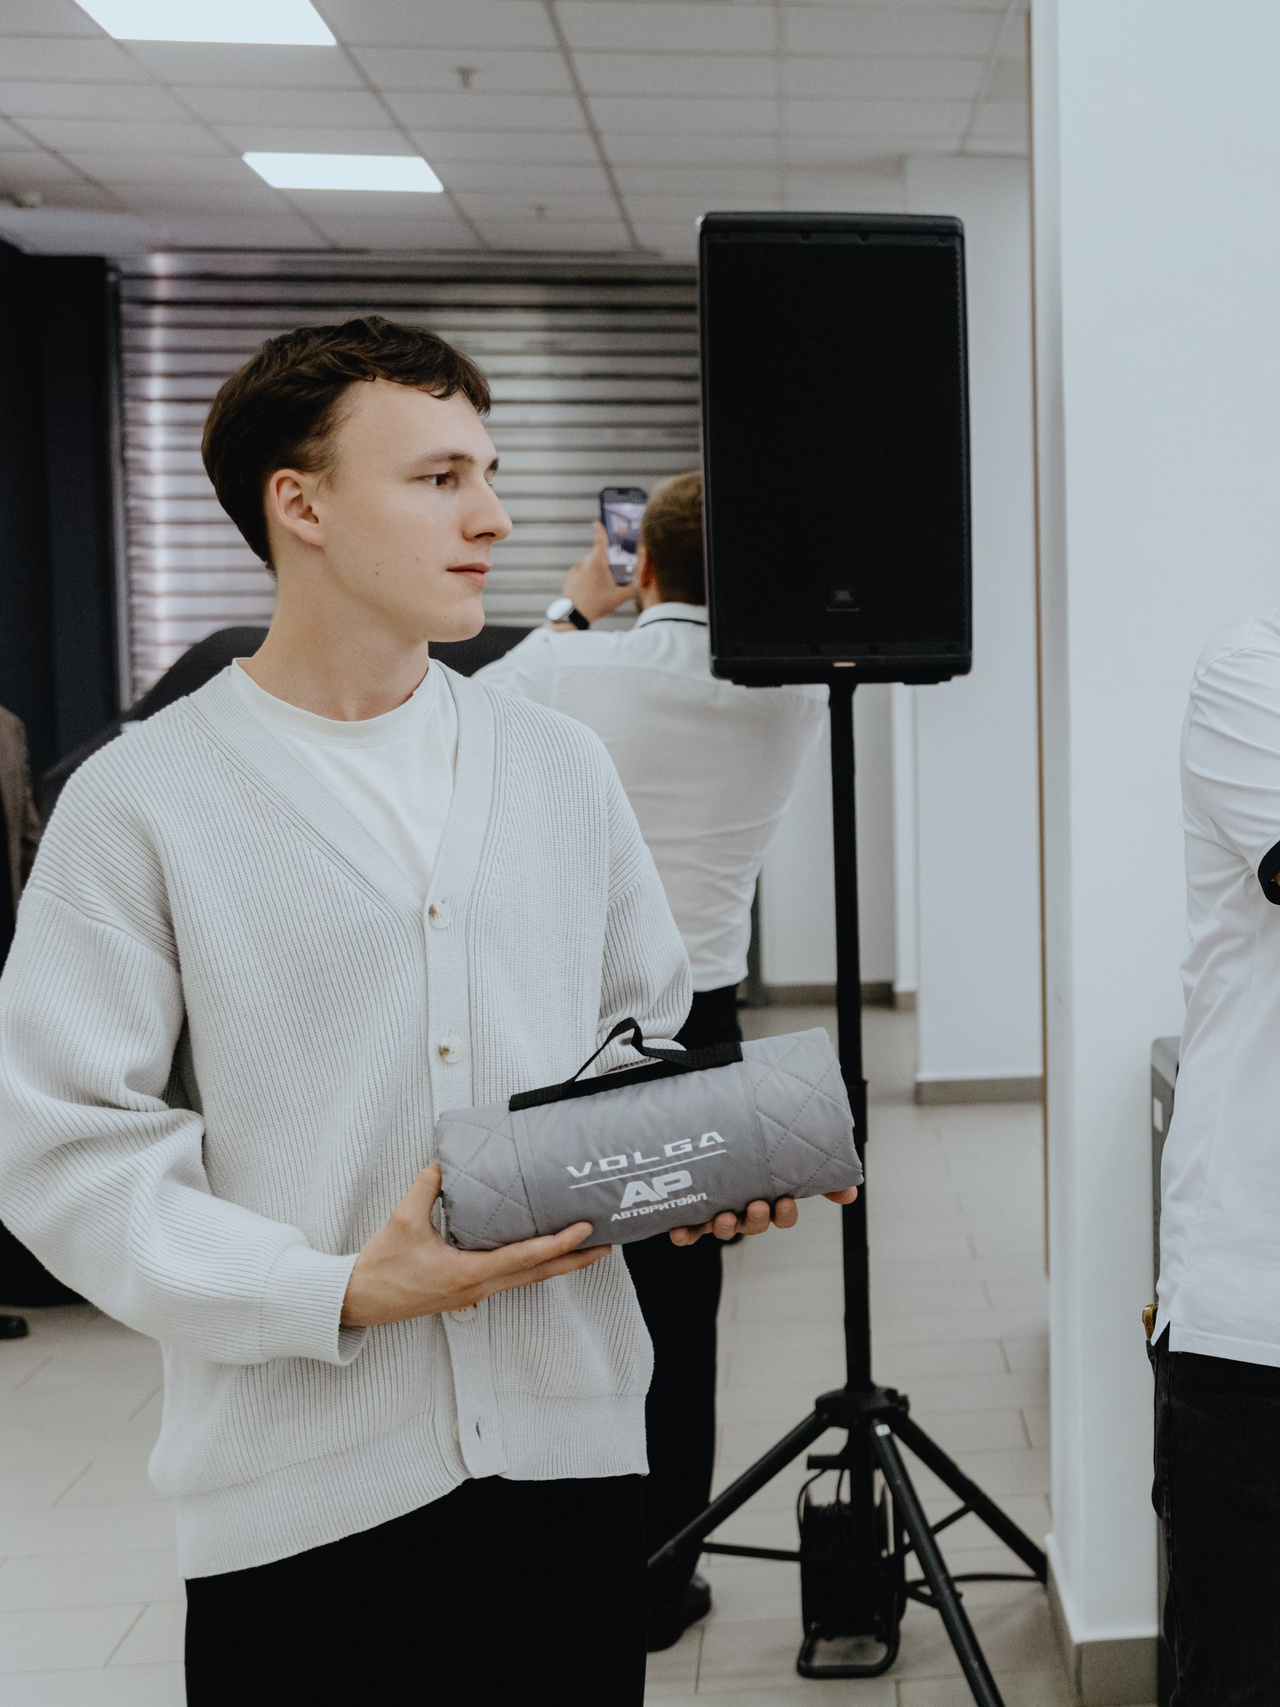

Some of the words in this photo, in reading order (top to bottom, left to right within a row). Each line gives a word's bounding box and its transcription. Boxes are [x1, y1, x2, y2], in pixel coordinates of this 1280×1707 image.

[566, 1131, 725, 1178] VOLGA
[611, 1192, 708, 1222] АВТОРИТЭЙЛ
[619, 1170, 693, 1209] АР
